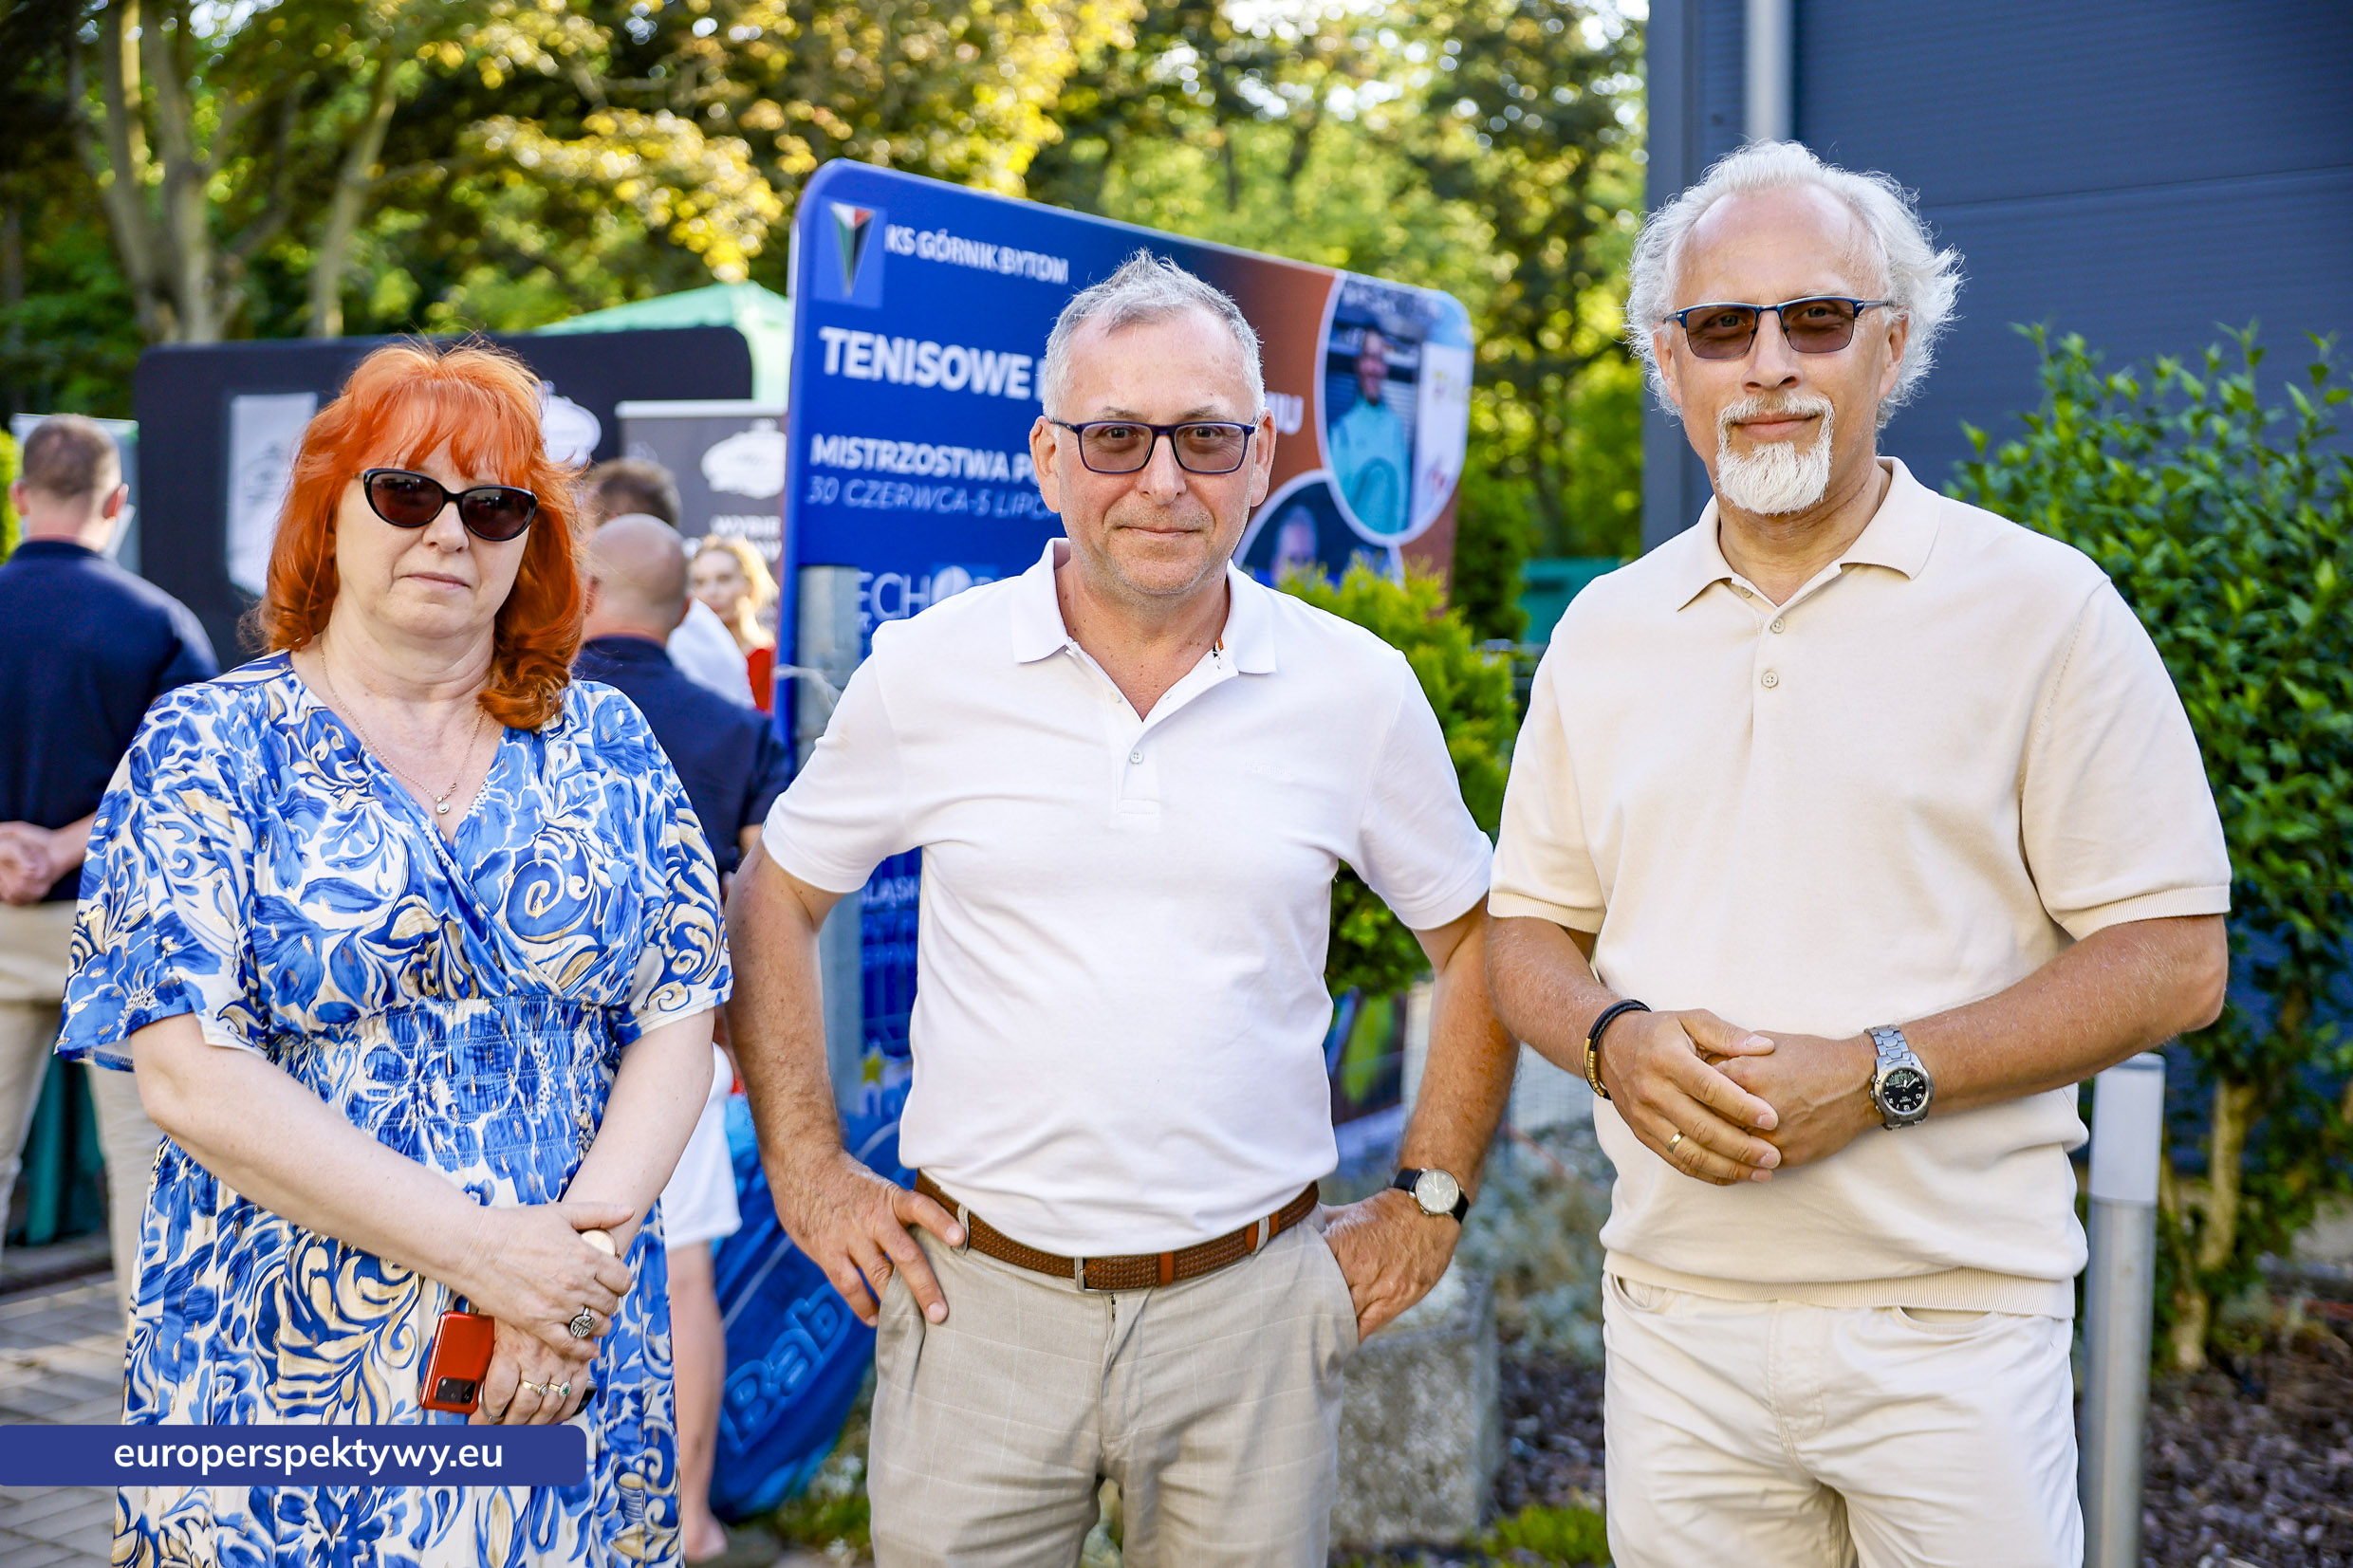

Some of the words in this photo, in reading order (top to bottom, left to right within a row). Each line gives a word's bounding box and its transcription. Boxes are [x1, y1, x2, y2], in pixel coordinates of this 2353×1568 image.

[884, 224, 916, 256] KS
[916, 228, 998, 272] GÓRNIK
[997, 246, 1068, 285] BYTOM
[819, 325, 1032, 400] TENISOWE
[810, 433, 1011, 483] MISTRZOSTWA
[806, 475, 840, 506] 30
[992, 491, 1060, 521] LIPC
